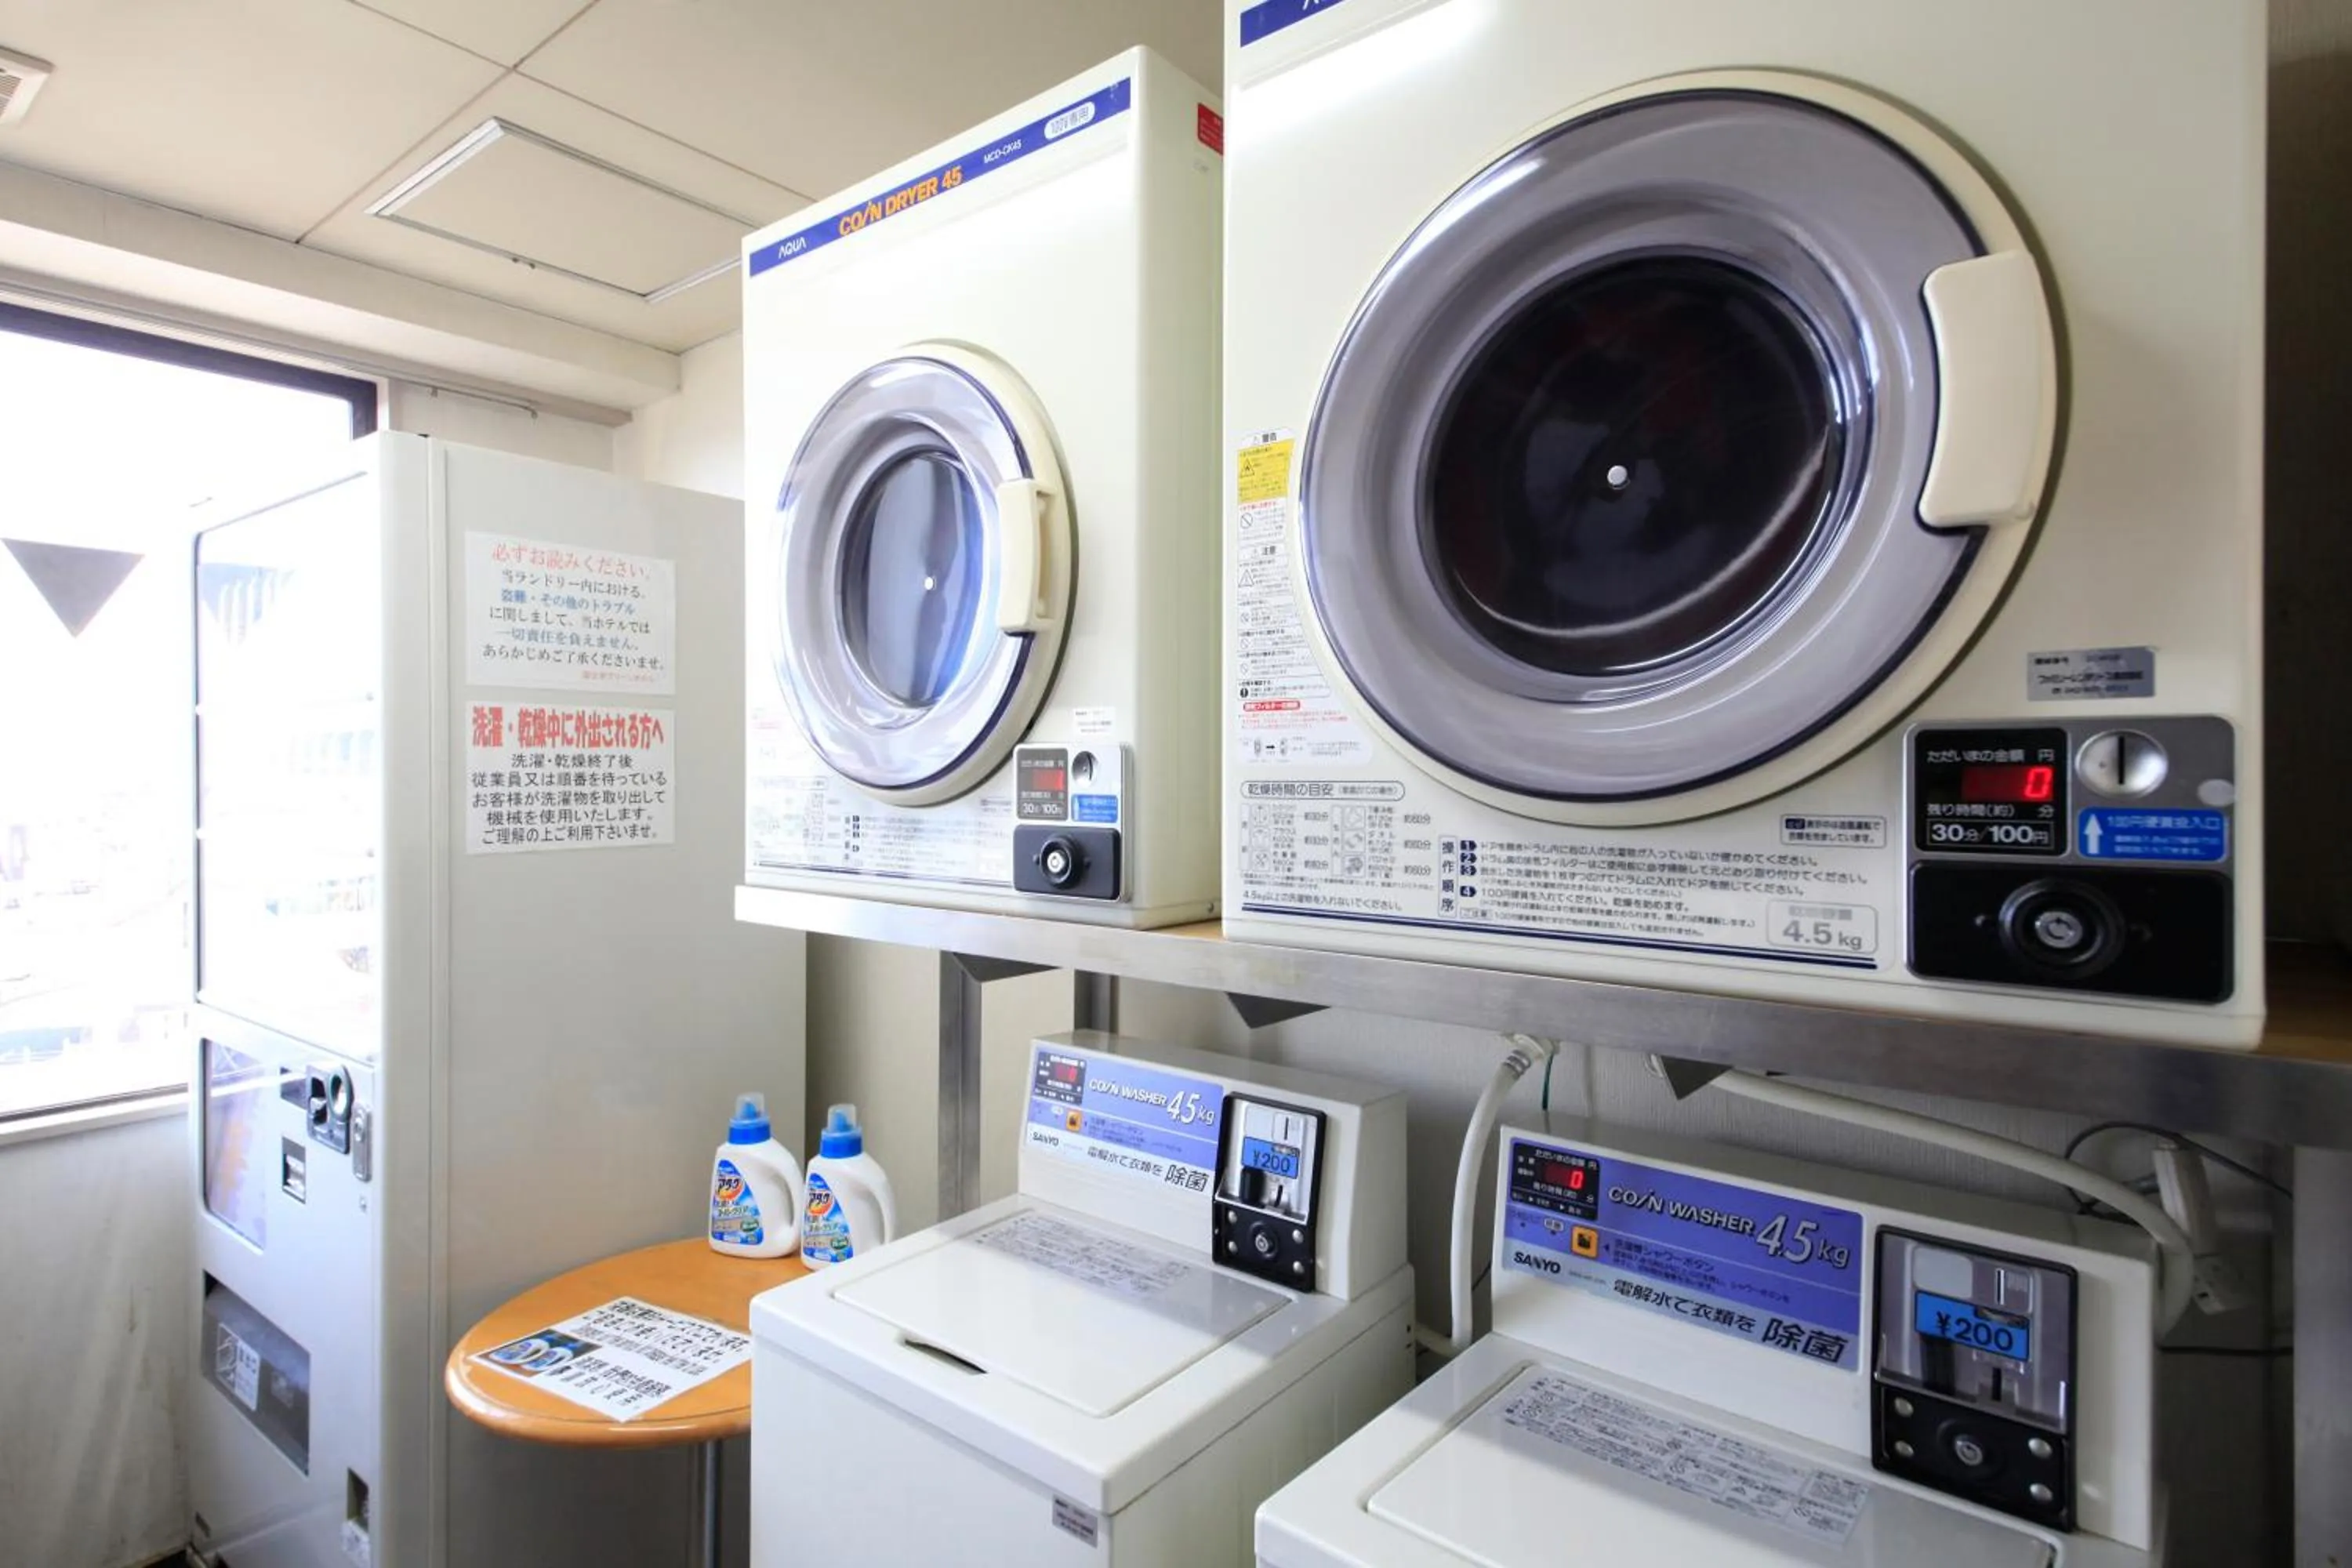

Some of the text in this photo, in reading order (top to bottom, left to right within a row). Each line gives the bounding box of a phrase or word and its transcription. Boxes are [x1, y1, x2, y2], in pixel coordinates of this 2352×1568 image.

[885, 176, 939, 216] DRYER
[942, 165, 963, 189] 45
[779, 237, 808, 259] AQUA
[492, 543, 652, 580] 必ずお読みください。
[472, 706, 664, 750] 洗濯・乾燥中に外出される方へ
[511, 753, 633, 769] 洗濯・乾燥終了後
[2038, 749, 2055, 762] 円
[471, 771, 668, 789] 従業員又は順番を待っている
[2024, 767, 2053, 798] 0
[472, 790, 666, 808] お客様が洗濯物を取り出して
[486, 808, 653, 826] 機械を使用いたします。
[2038, 804, 2055, 818] 分
[482, 825, 657, 845] ご理解の上ご利用下さいませ。
[1782, 919, 1863, 950] 4.5 kg
[1121, 1085, 1167, 1106] WASHER
[1033, 1131, 1060, 1147] SANYO
[1164, 1163, 1210, 1192] 除菌
[1570, 1170, 1584, 1189] 0
[1668, 1200, 1755, 1236] WASHER
[1513, 1250, 1562, 1276] SANYO
[1612, 1278, 1849, 1365] 電解水で衣類を 除菌
[1936, 1309, 2014, 1352] ¥200
